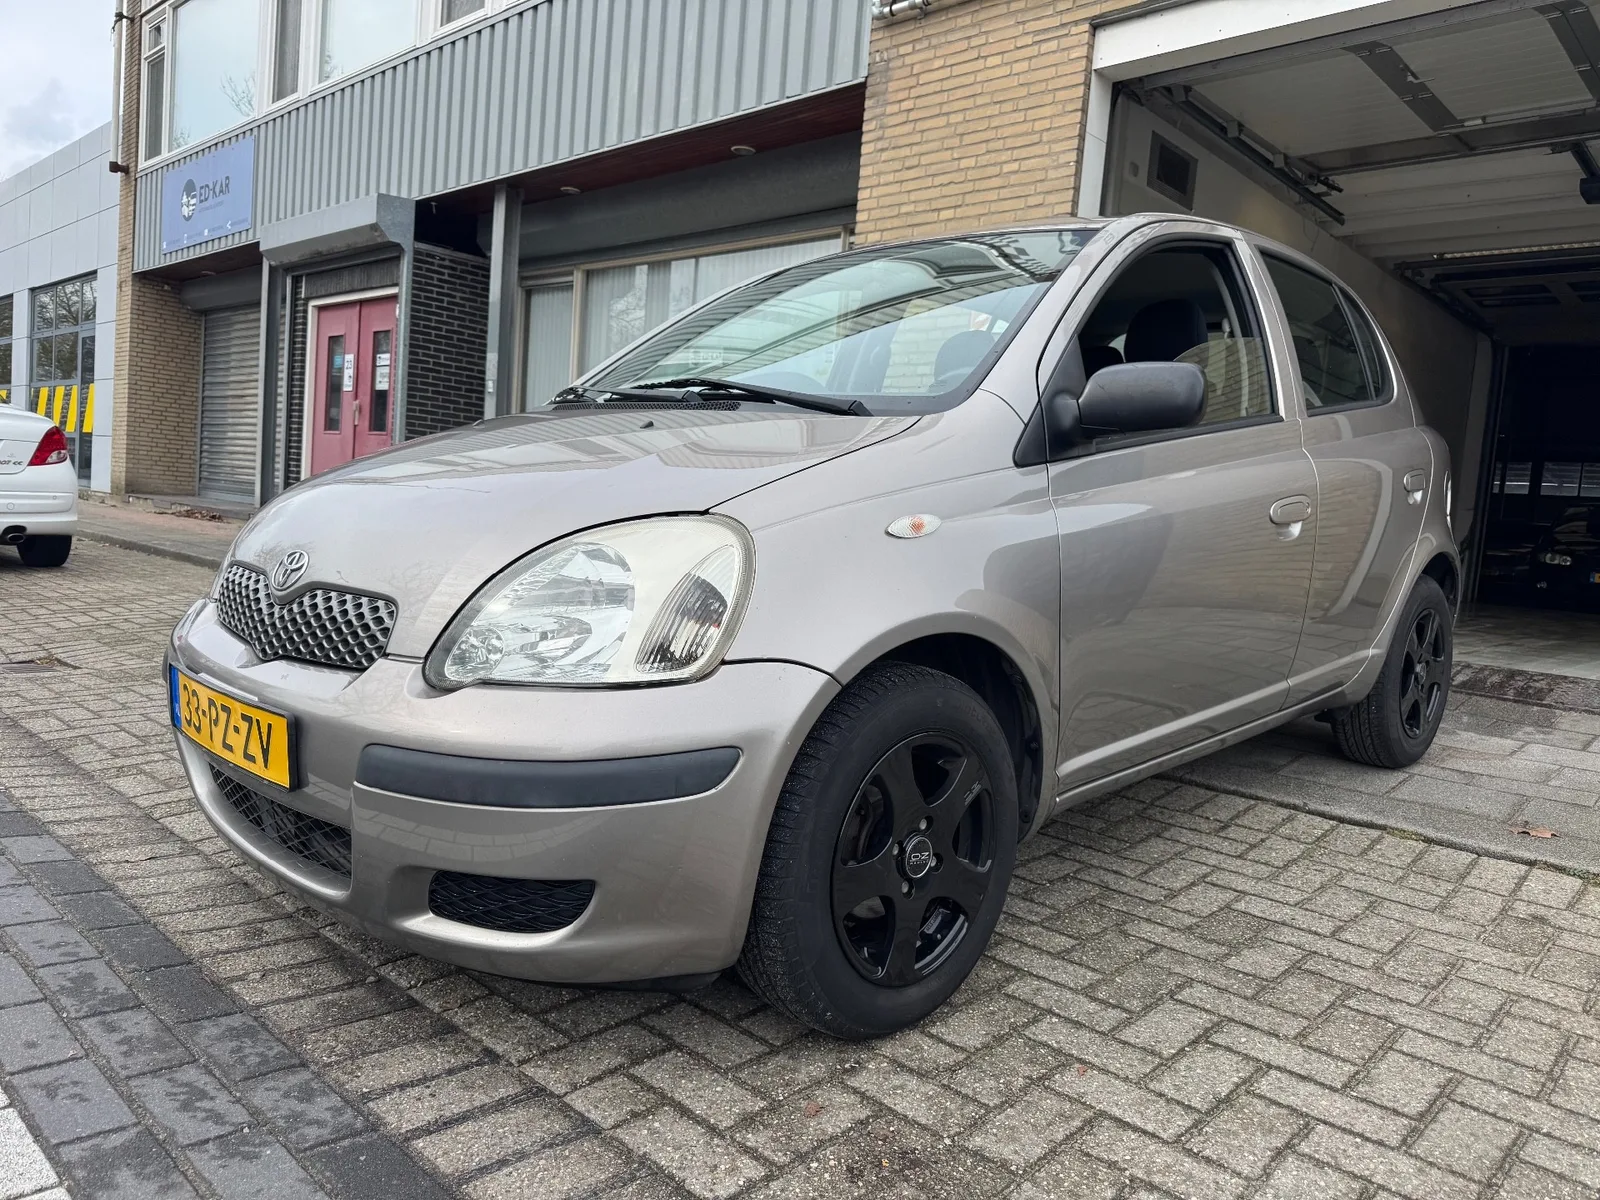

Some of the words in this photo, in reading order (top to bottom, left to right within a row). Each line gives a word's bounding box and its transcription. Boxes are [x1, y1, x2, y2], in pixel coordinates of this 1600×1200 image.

[199, 175, 230, 204] ED-KAR
[183, 683, 272, 770] 33-PZ-ZV
[911, 852, 930, 860] OZ
